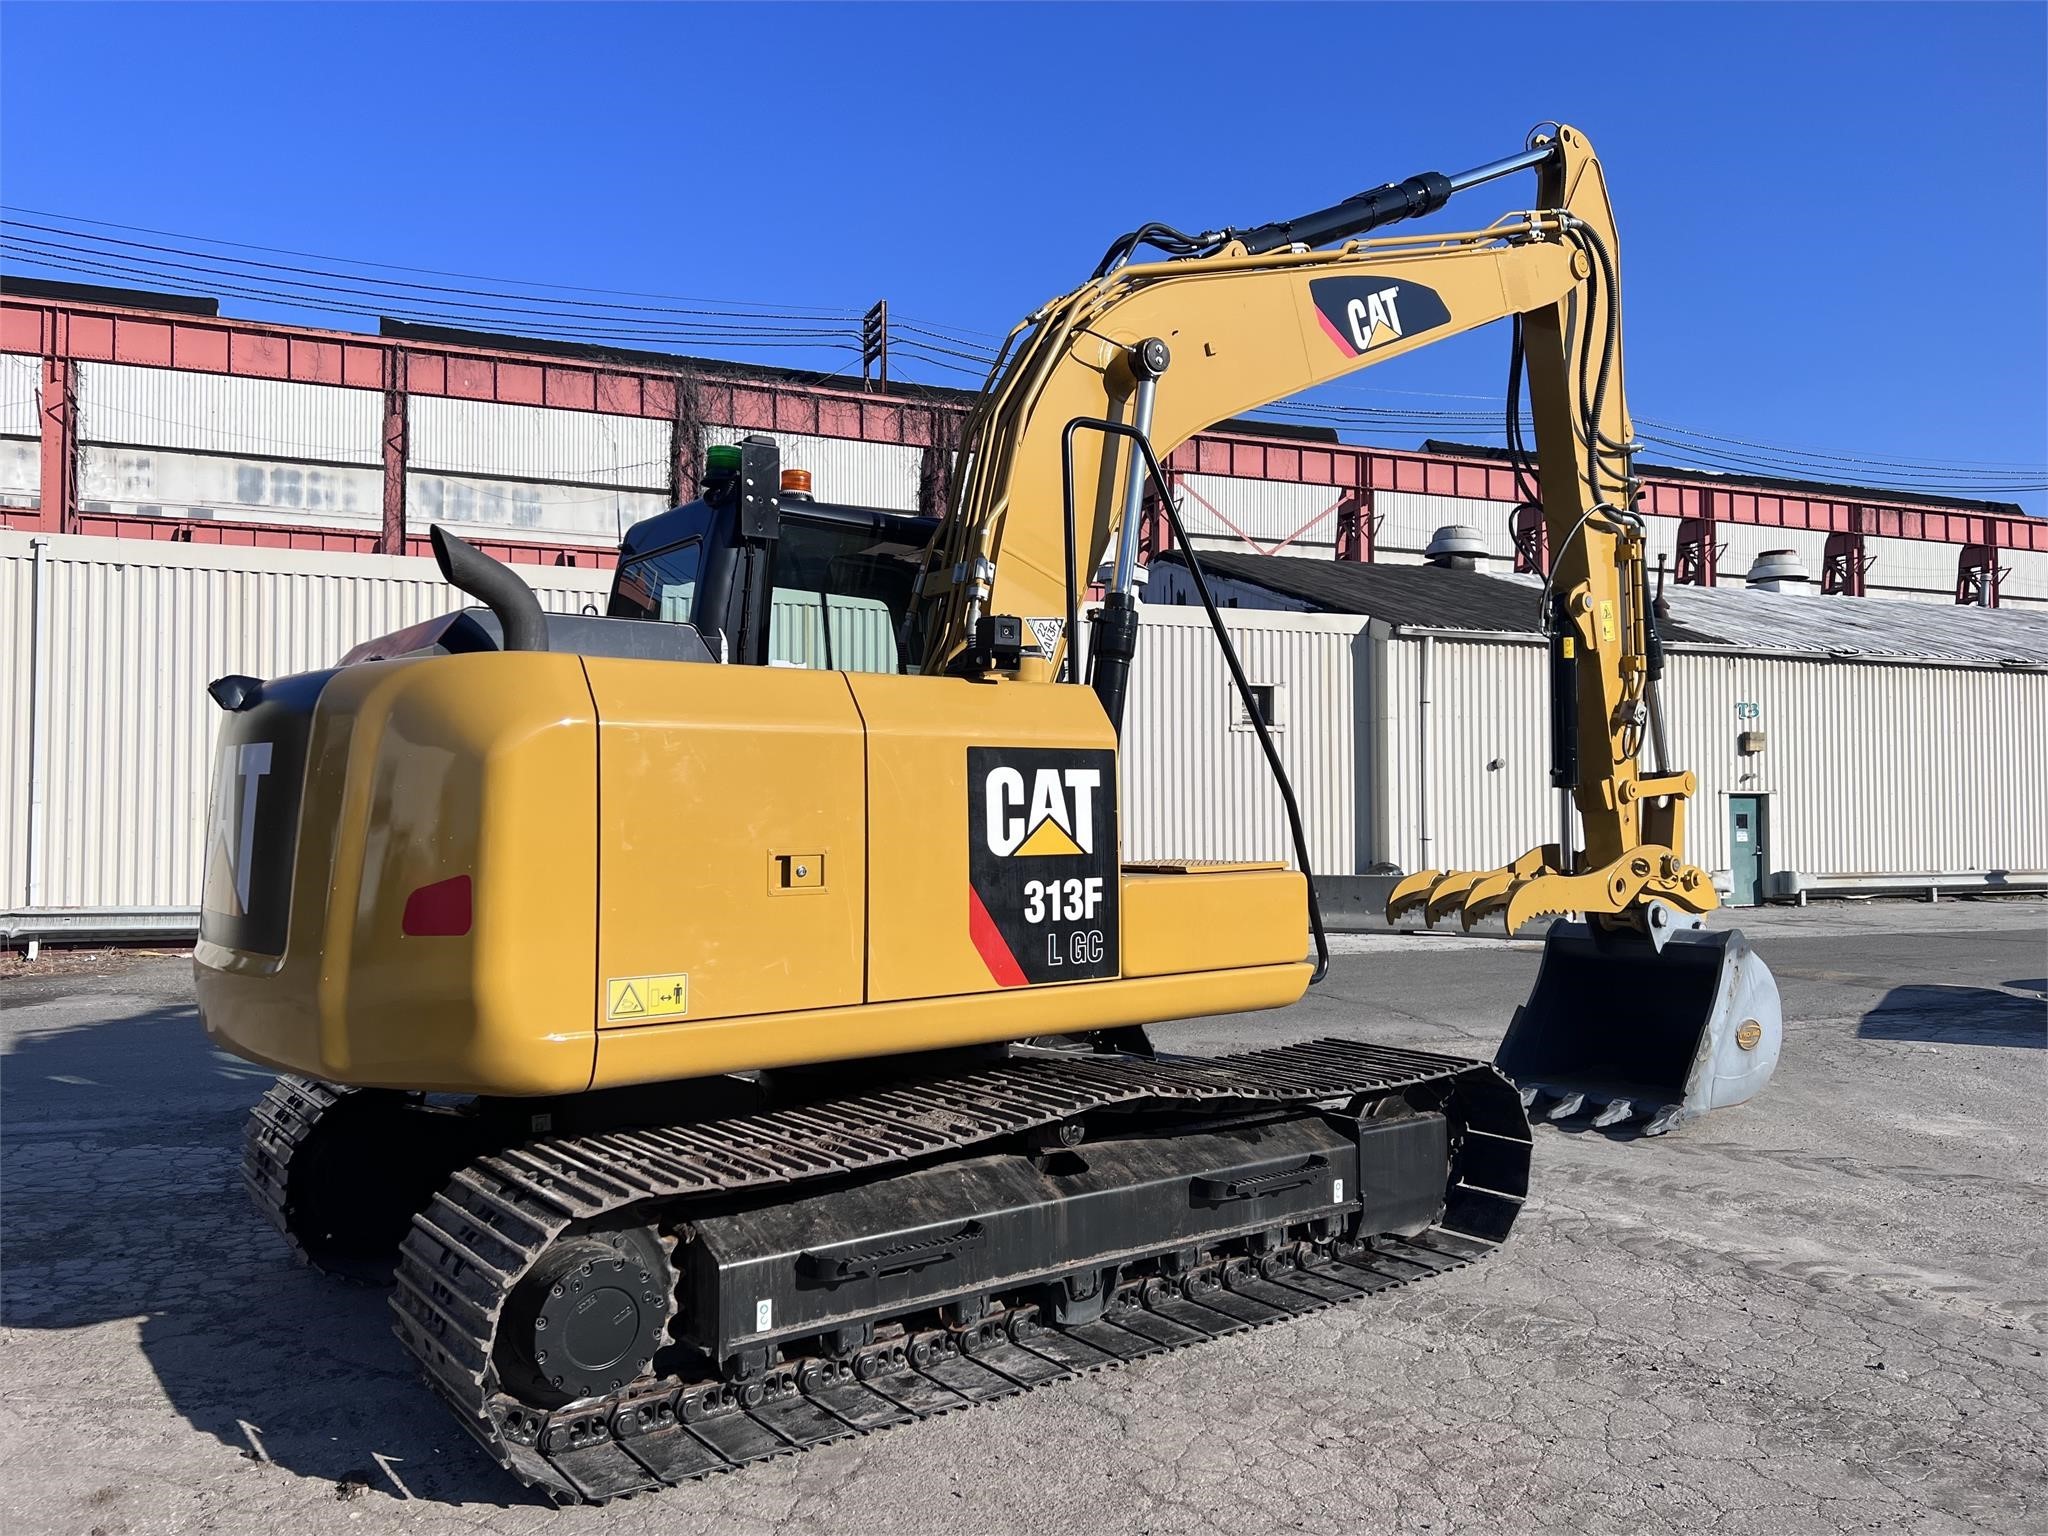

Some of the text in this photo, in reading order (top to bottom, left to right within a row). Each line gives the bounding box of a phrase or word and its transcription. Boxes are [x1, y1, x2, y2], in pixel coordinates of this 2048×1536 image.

[1347, 286, 1402, 350] CAT
[1736, 702, 1760, 719] T3
[203, 742, 274, 914] AT
[985, 766, 1101, 857] CAT
[1024, 877, 1103, 924] 313F
[1048, 930, 1103, 966] L GC
